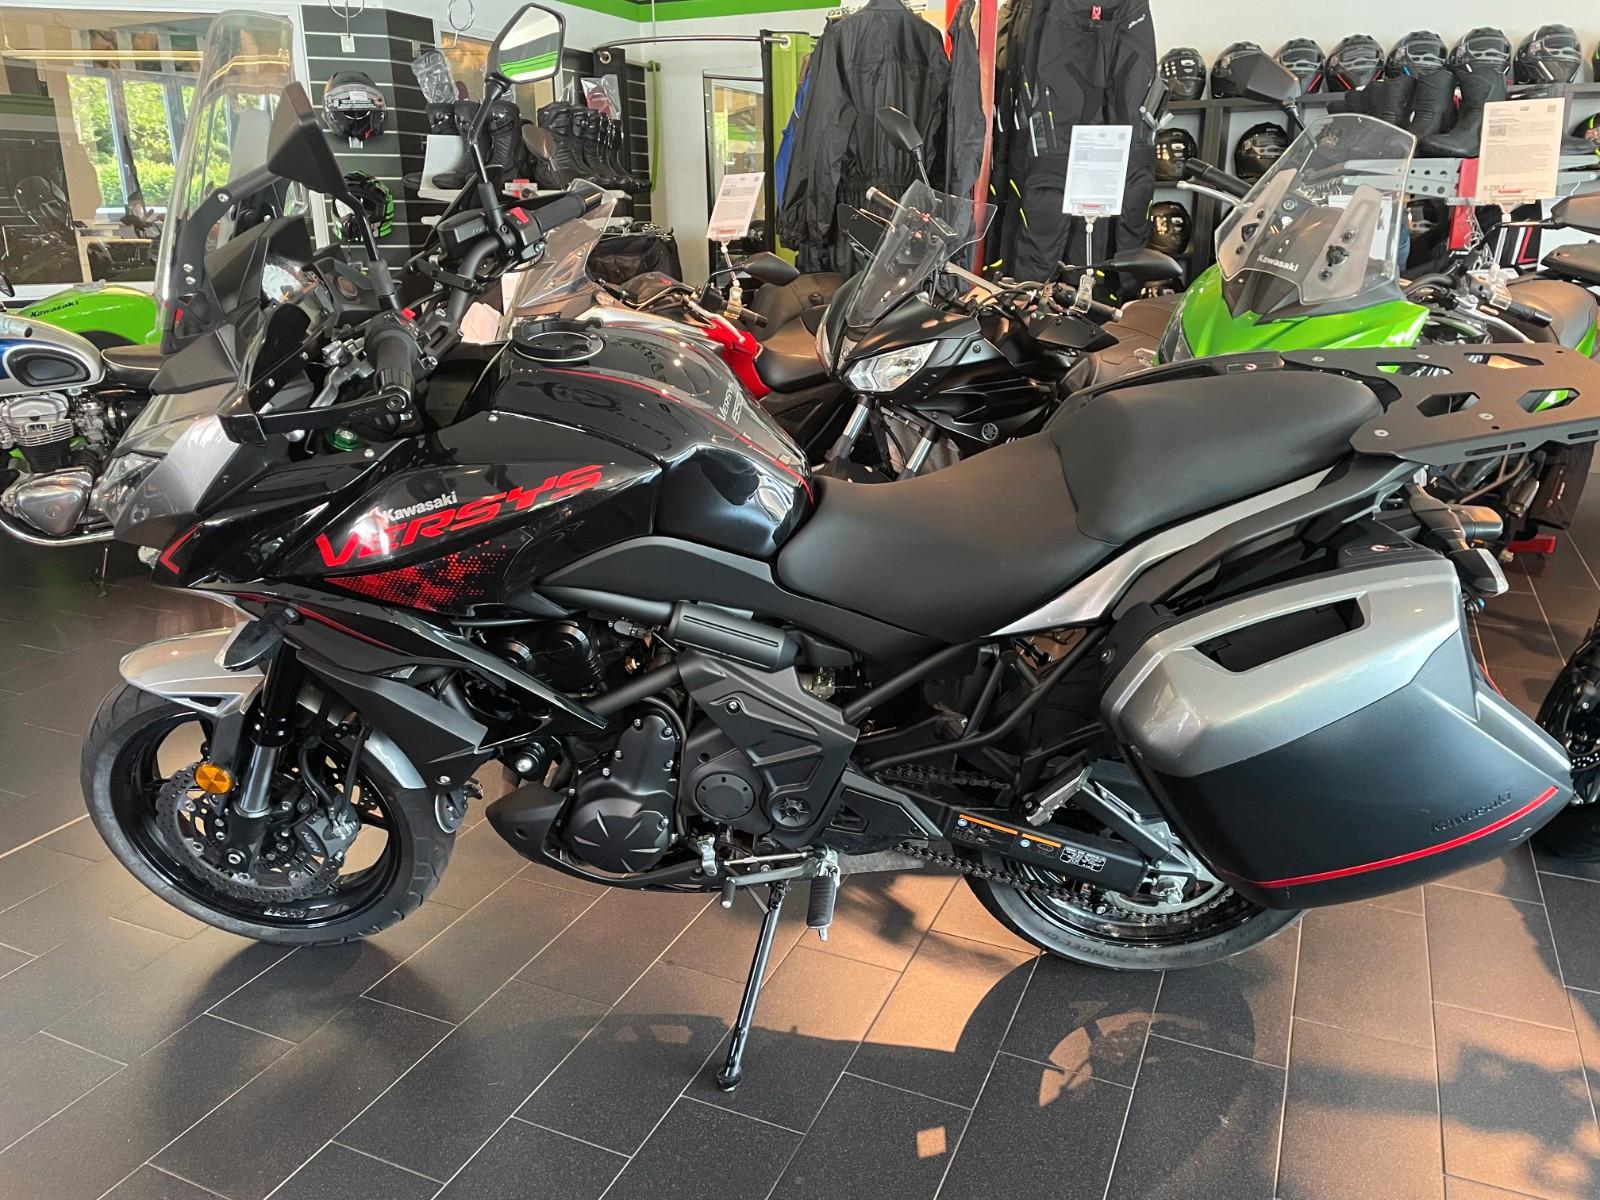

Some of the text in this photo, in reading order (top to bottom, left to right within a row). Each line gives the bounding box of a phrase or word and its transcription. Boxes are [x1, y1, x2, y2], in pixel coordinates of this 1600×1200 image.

[1256, 254, 1299, 272] Kawasaki
[315, 464, 604, 567] VERSYS
[381, 488, 458, 522] Kawasaki
[1431, 789, 1512, 833] Kawasaki
